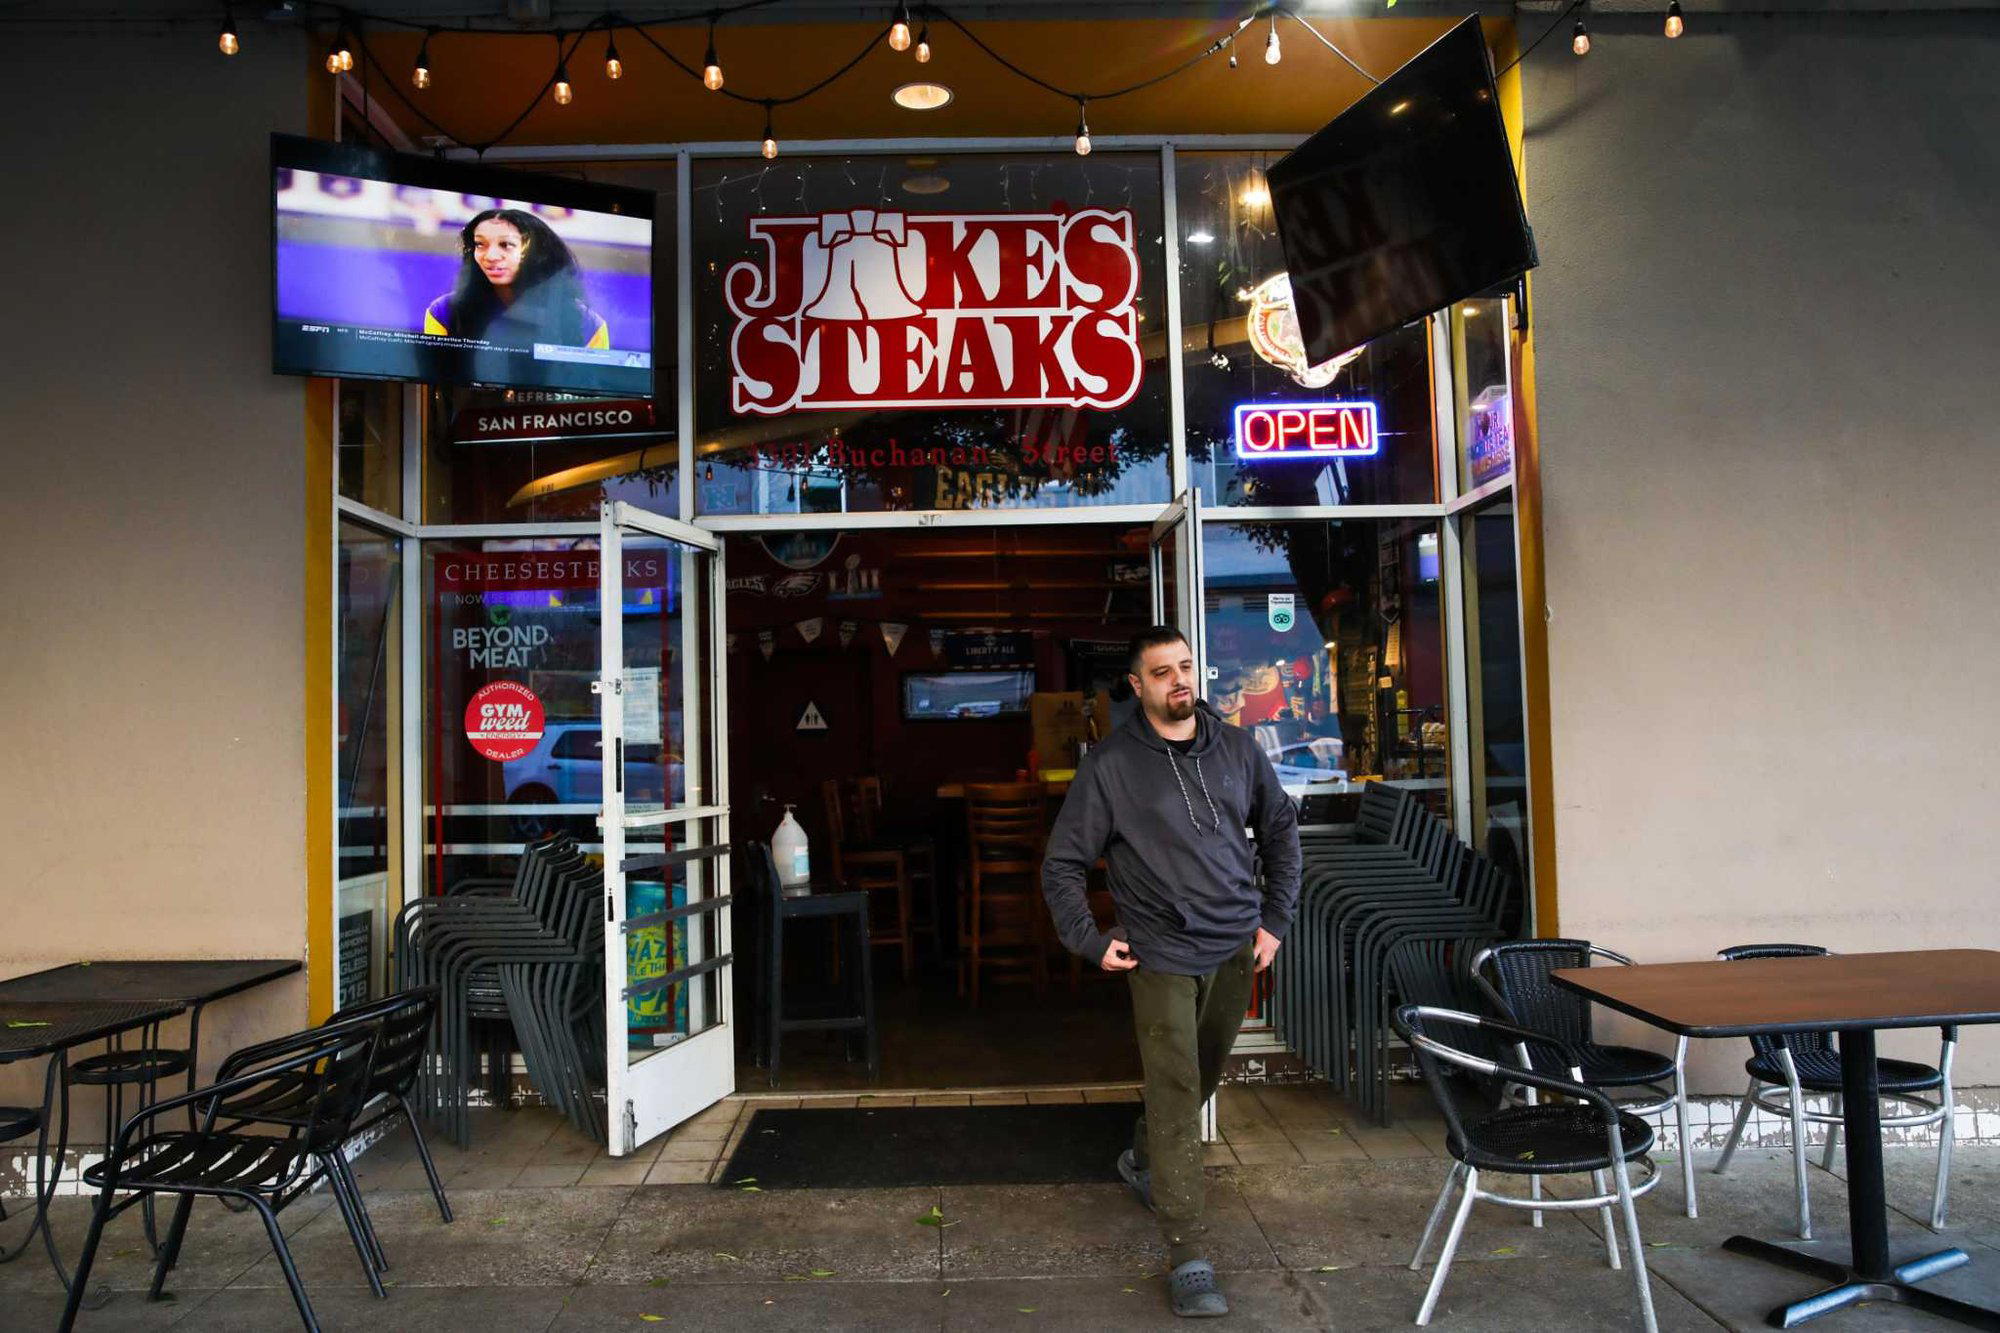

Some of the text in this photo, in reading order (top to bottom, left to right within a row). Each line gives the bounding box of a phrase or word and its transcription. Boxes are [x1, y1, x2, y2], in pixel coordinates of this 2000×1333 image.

[302, 324, 329, 333] ESPN
[731, 306, 1144, 414] STEAKS
[478, 410, 633, 432] SAN FRANCISCO
[1243, 408, 1370, 452] OPEN
[828, 437, 990, 468] Buchanan
[1020, 436, 1119, 465] Street
[444, 560, 658, 582] CHEESESTEKS
[452, 625, 549, 649] BEYOND
[470, 647, 532, 669] MEAT
[478, 682, 535, 701] AUTHORIZED
[480, 703, 524, 717] GYM
[480, 710, 532, 731] weed
[486, 748, 524, 759] DEALER
